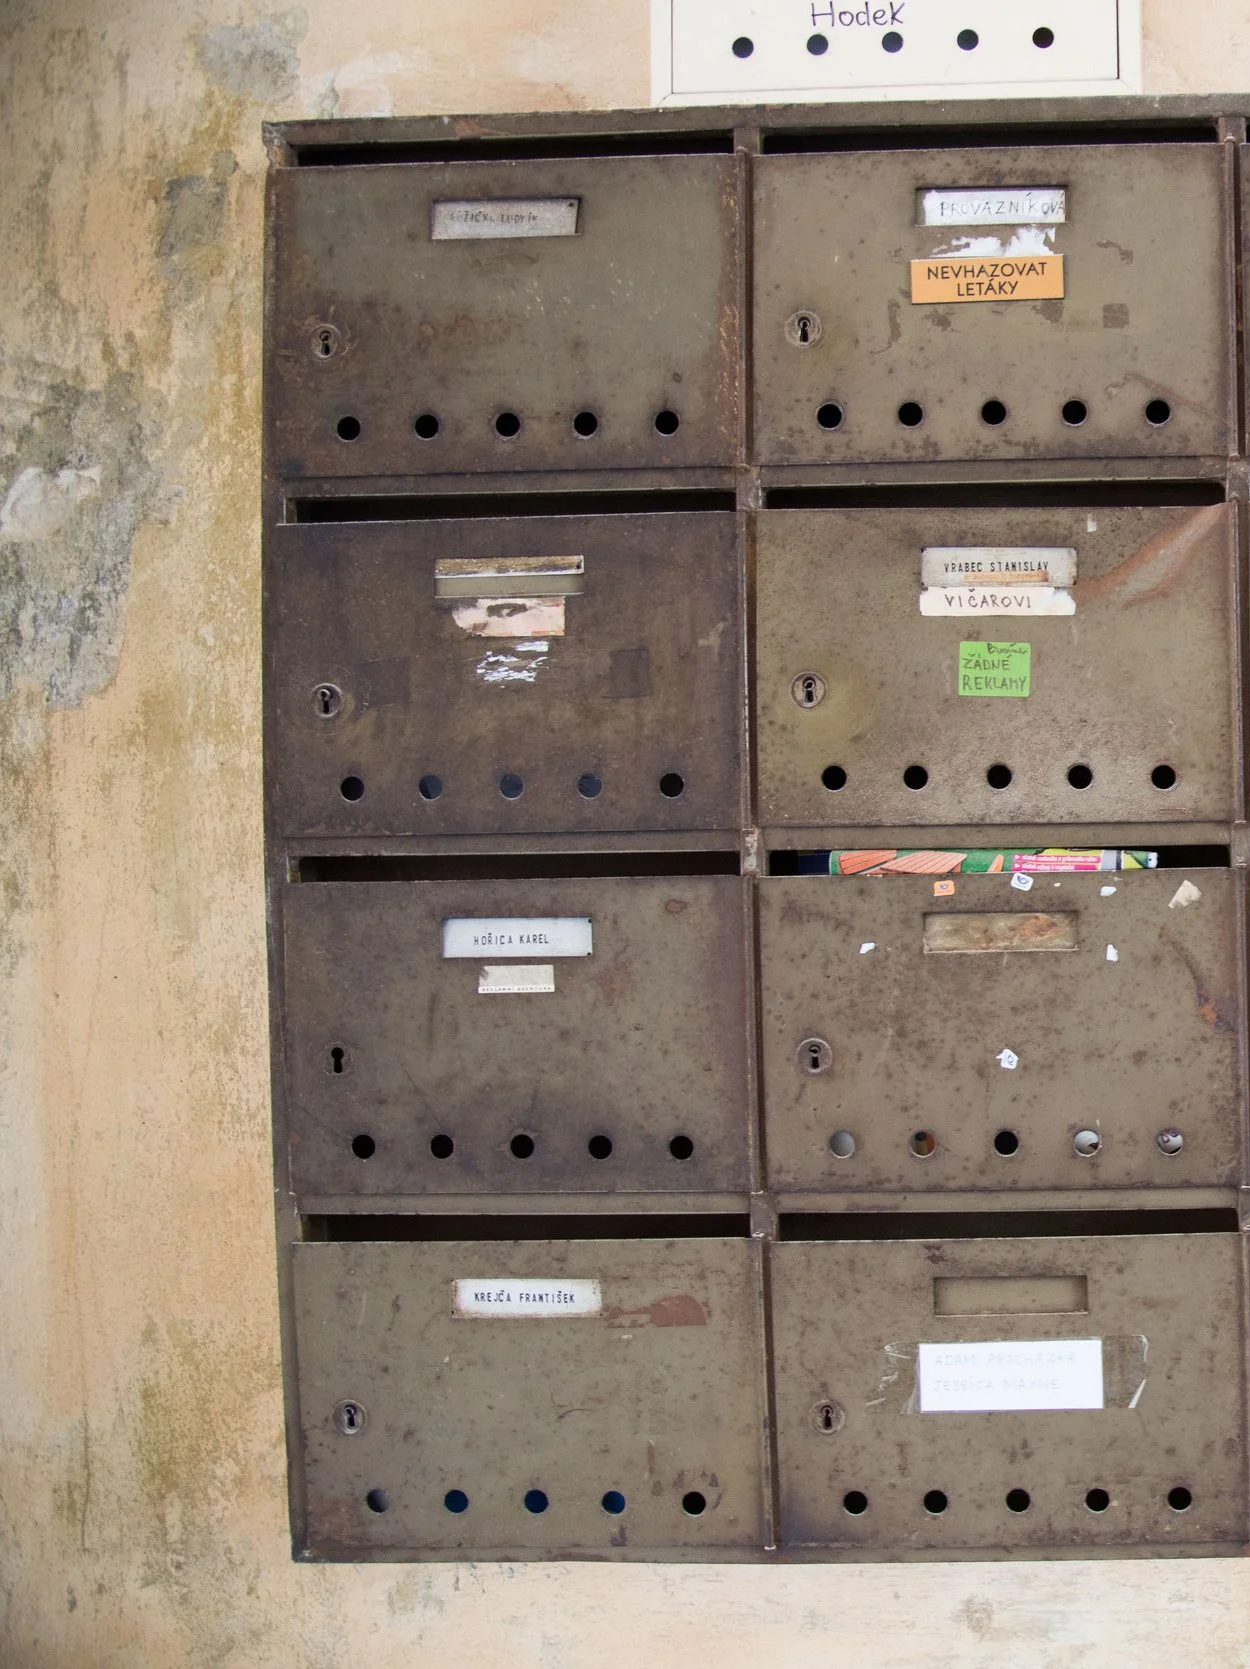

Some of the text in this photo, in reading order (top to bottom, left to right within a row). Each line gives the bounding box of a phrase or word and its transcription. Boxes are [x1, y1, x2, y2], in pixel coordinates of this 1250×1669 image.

[810, 1, 907, 28] Hodek
[926, 261, 1048, 281] NEVHAZOVAT
[956, 278, 1019, 297] LETÁKY
[944, 560, 1049, 573] VRABEC STANISLAV
[944, 588, 1032, 609] VIČAROVI
[961, 652, 1012, 671] ŽÁDNÉ
[961, 674, 1027, 692] REKLAMY
[473, 932, 550, 946] HOŘICA KAREL
[474, 1289, 576, 1303] KREJČA FRANTIŠEK
